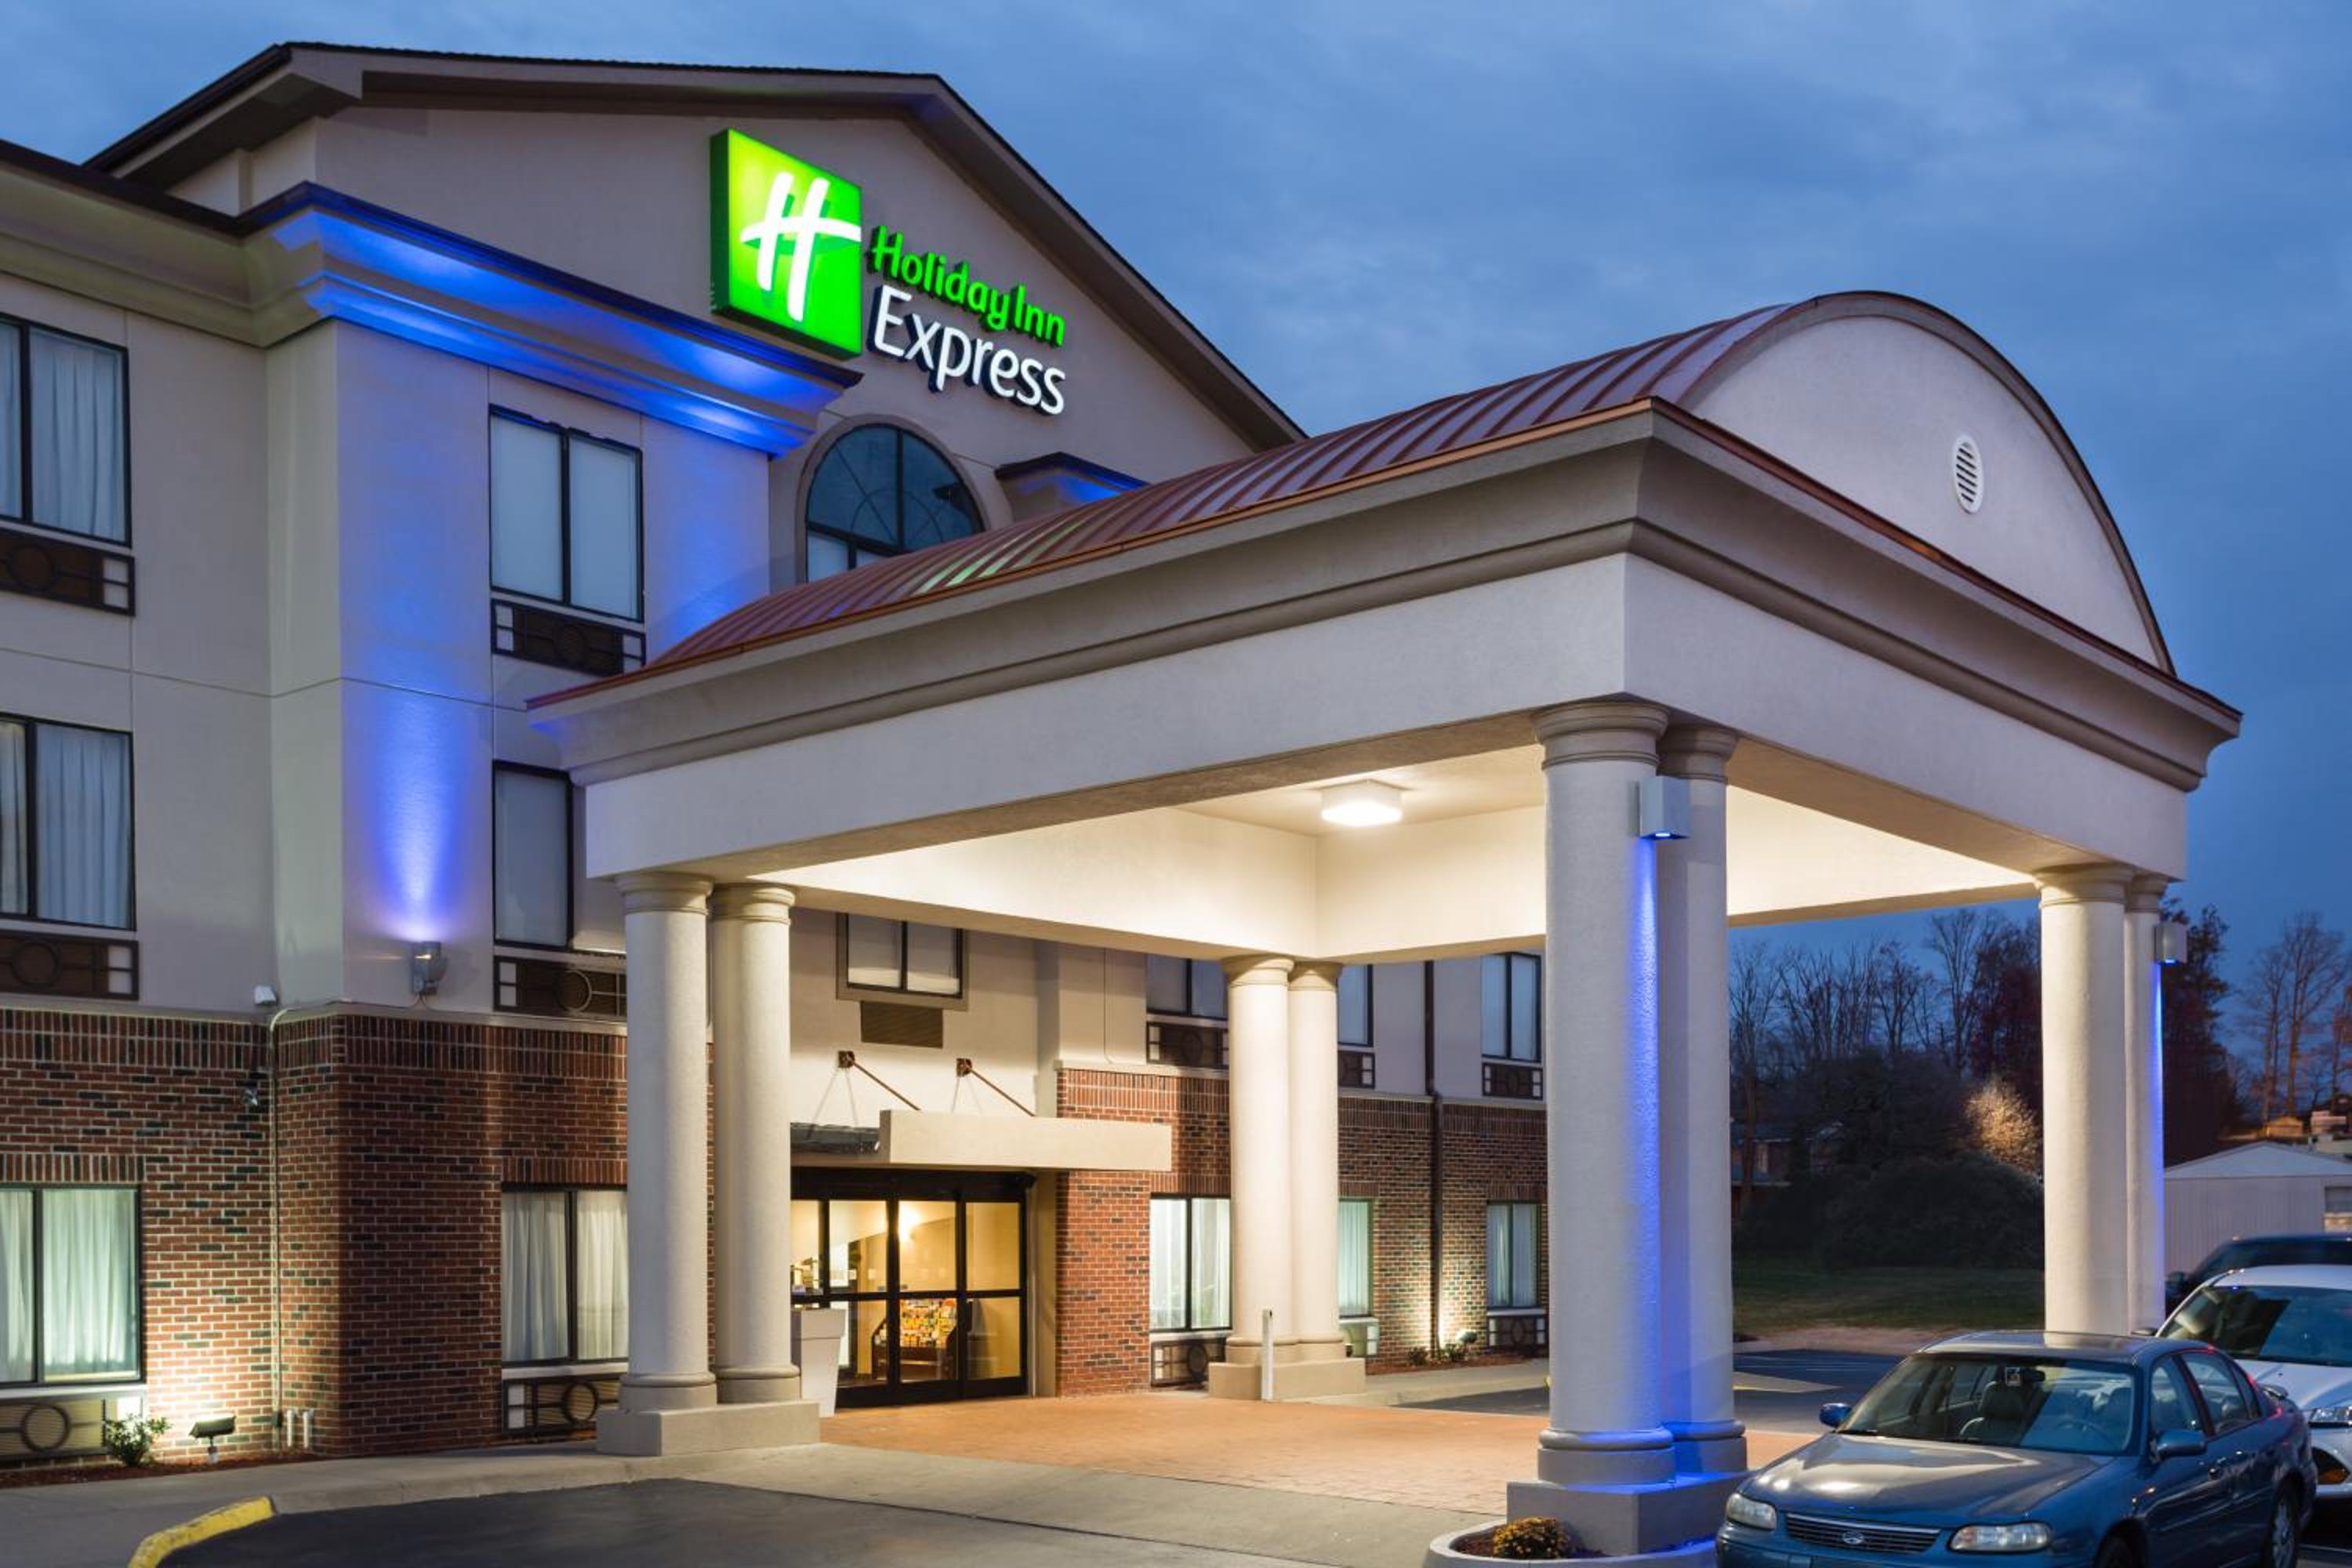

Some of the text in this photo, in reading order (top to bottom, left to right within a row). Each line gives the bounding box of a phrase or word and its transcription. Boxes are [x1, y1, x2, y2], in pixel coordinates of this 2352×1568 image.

[741, 172, 862, 322] H
[870, 225, 1065, 347] Holiday Inn
[872, 285, 1066, 416] Express
